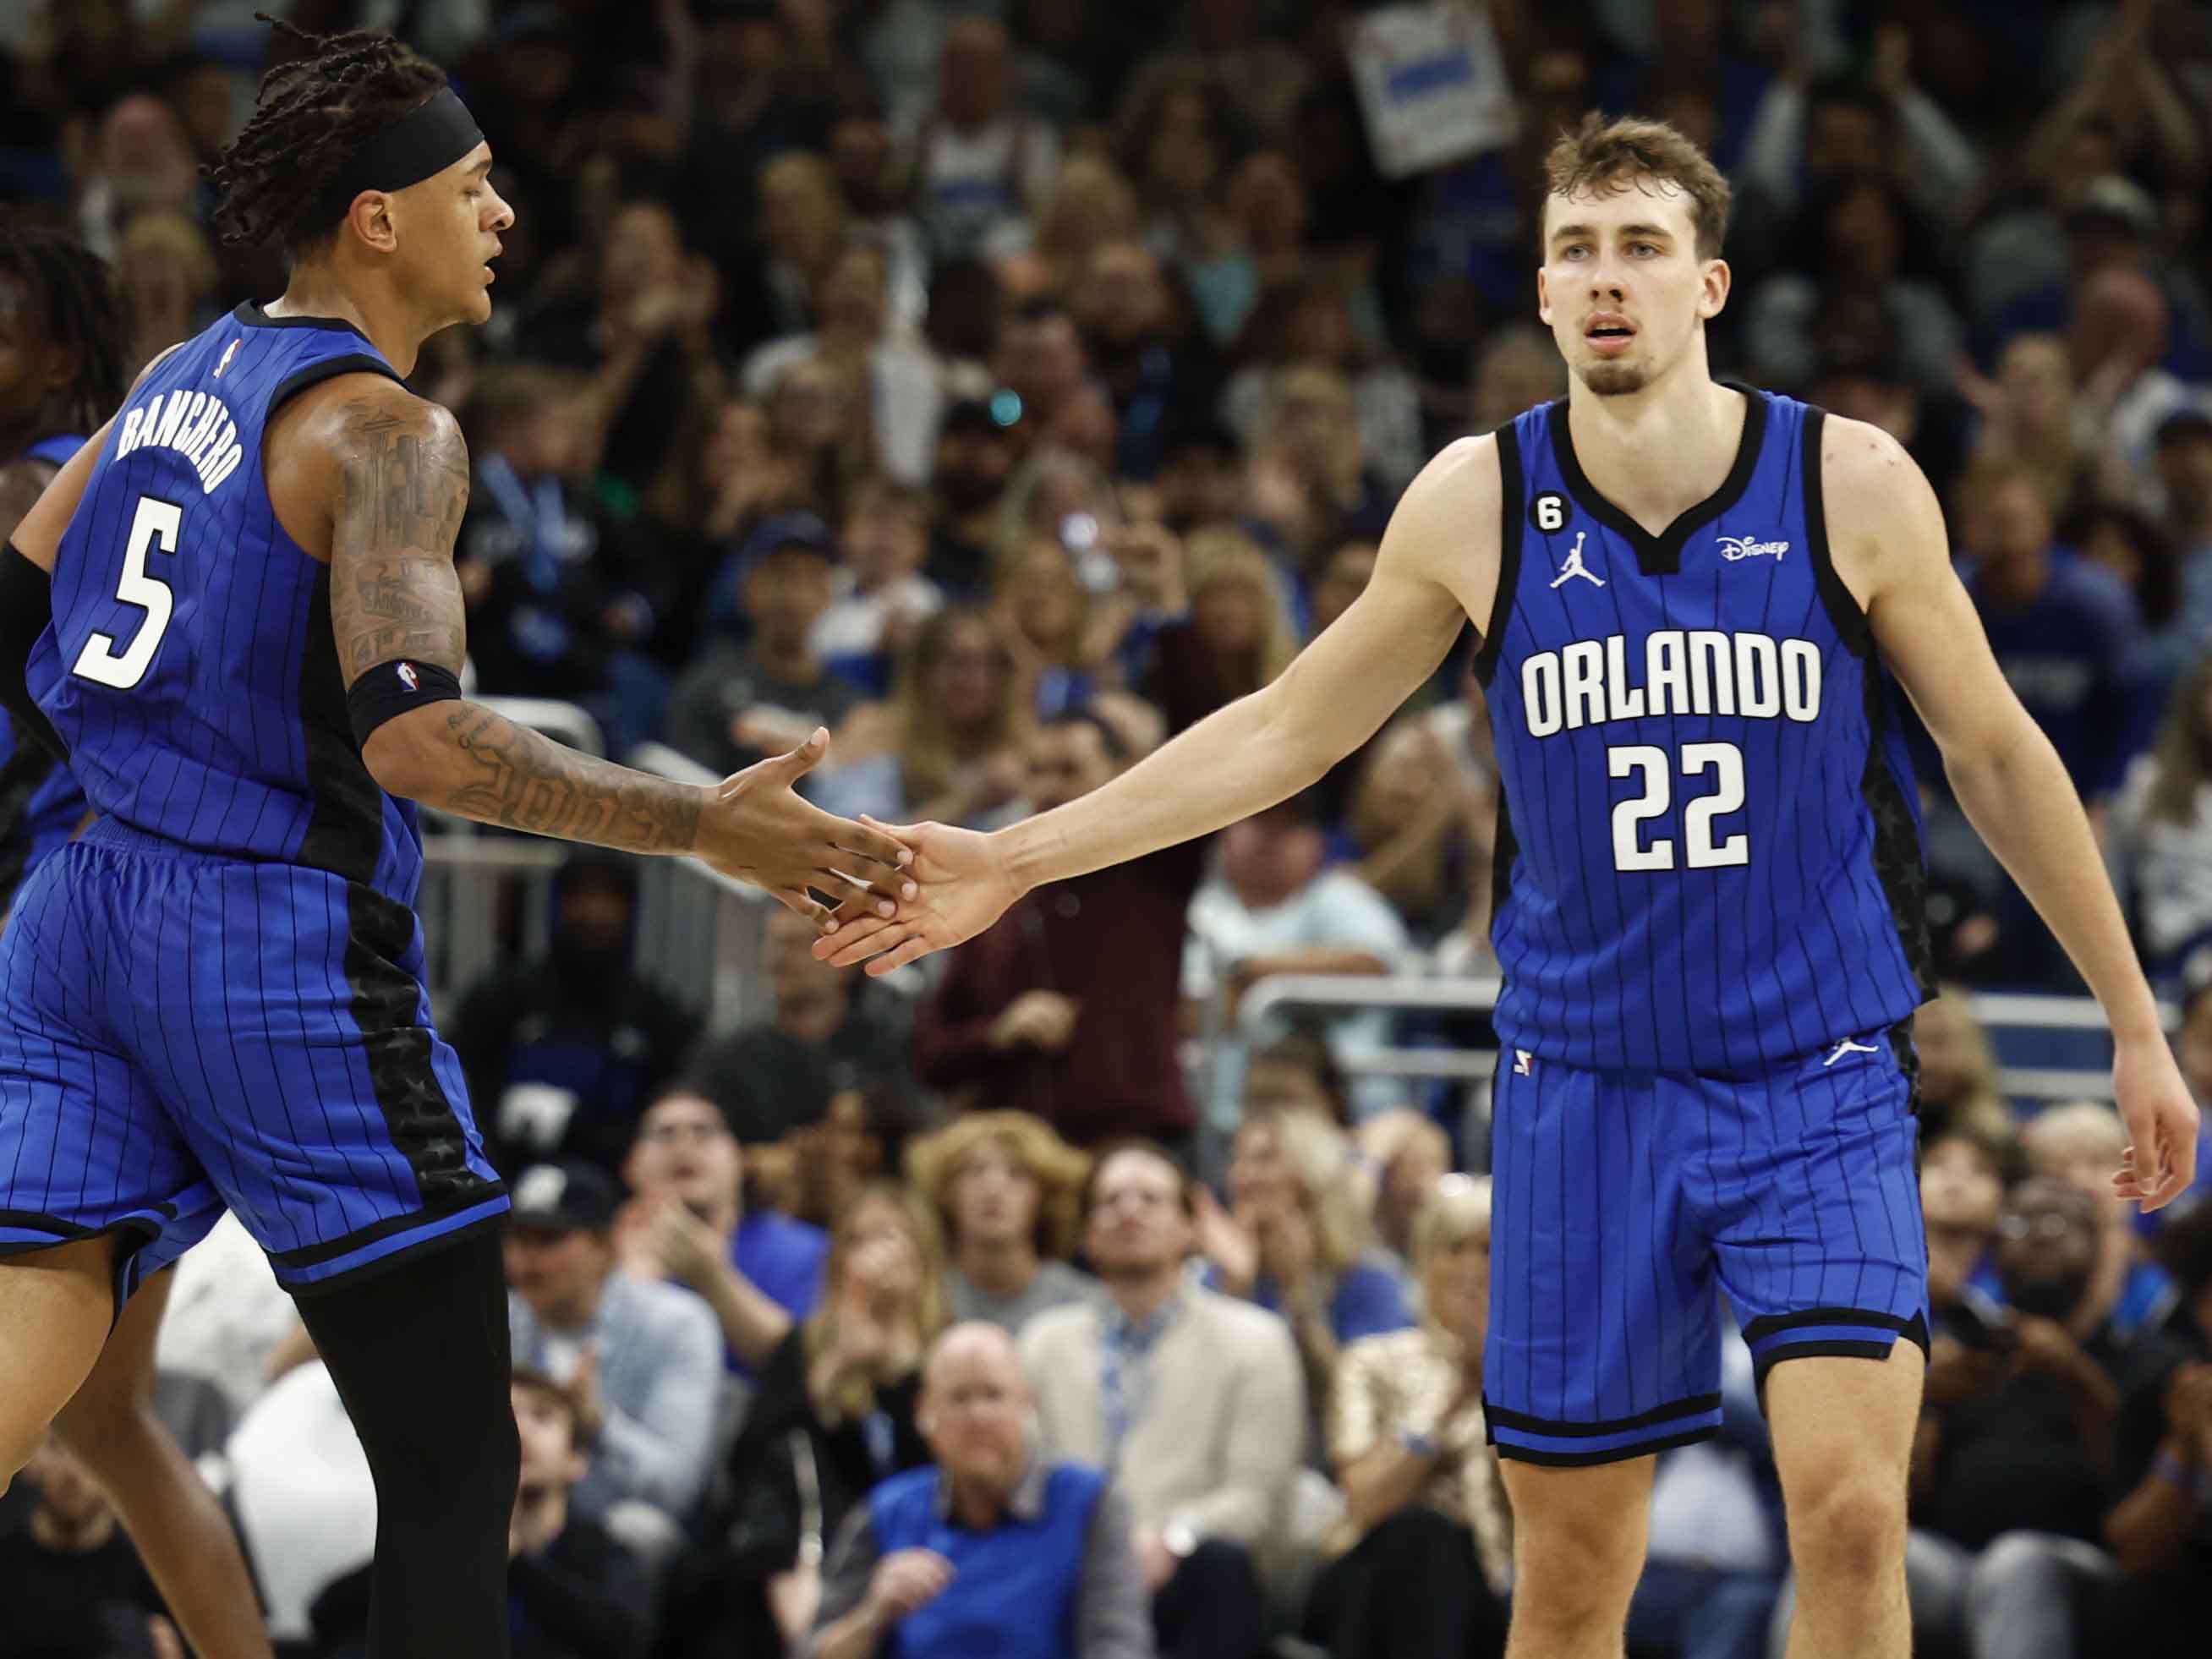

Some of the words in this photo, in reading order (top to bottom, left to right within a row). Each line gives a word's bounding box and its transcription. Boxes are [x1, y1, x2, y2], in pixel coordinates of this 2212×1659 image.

[115, 389, 243, 495] BANCHERO
[1537, 496, 1563, 530] 6
[73, 496, 183, 689] 5
[1522, 630, 1821, 737] ORLANDO
[1608, 742, 1749, 871] 22
